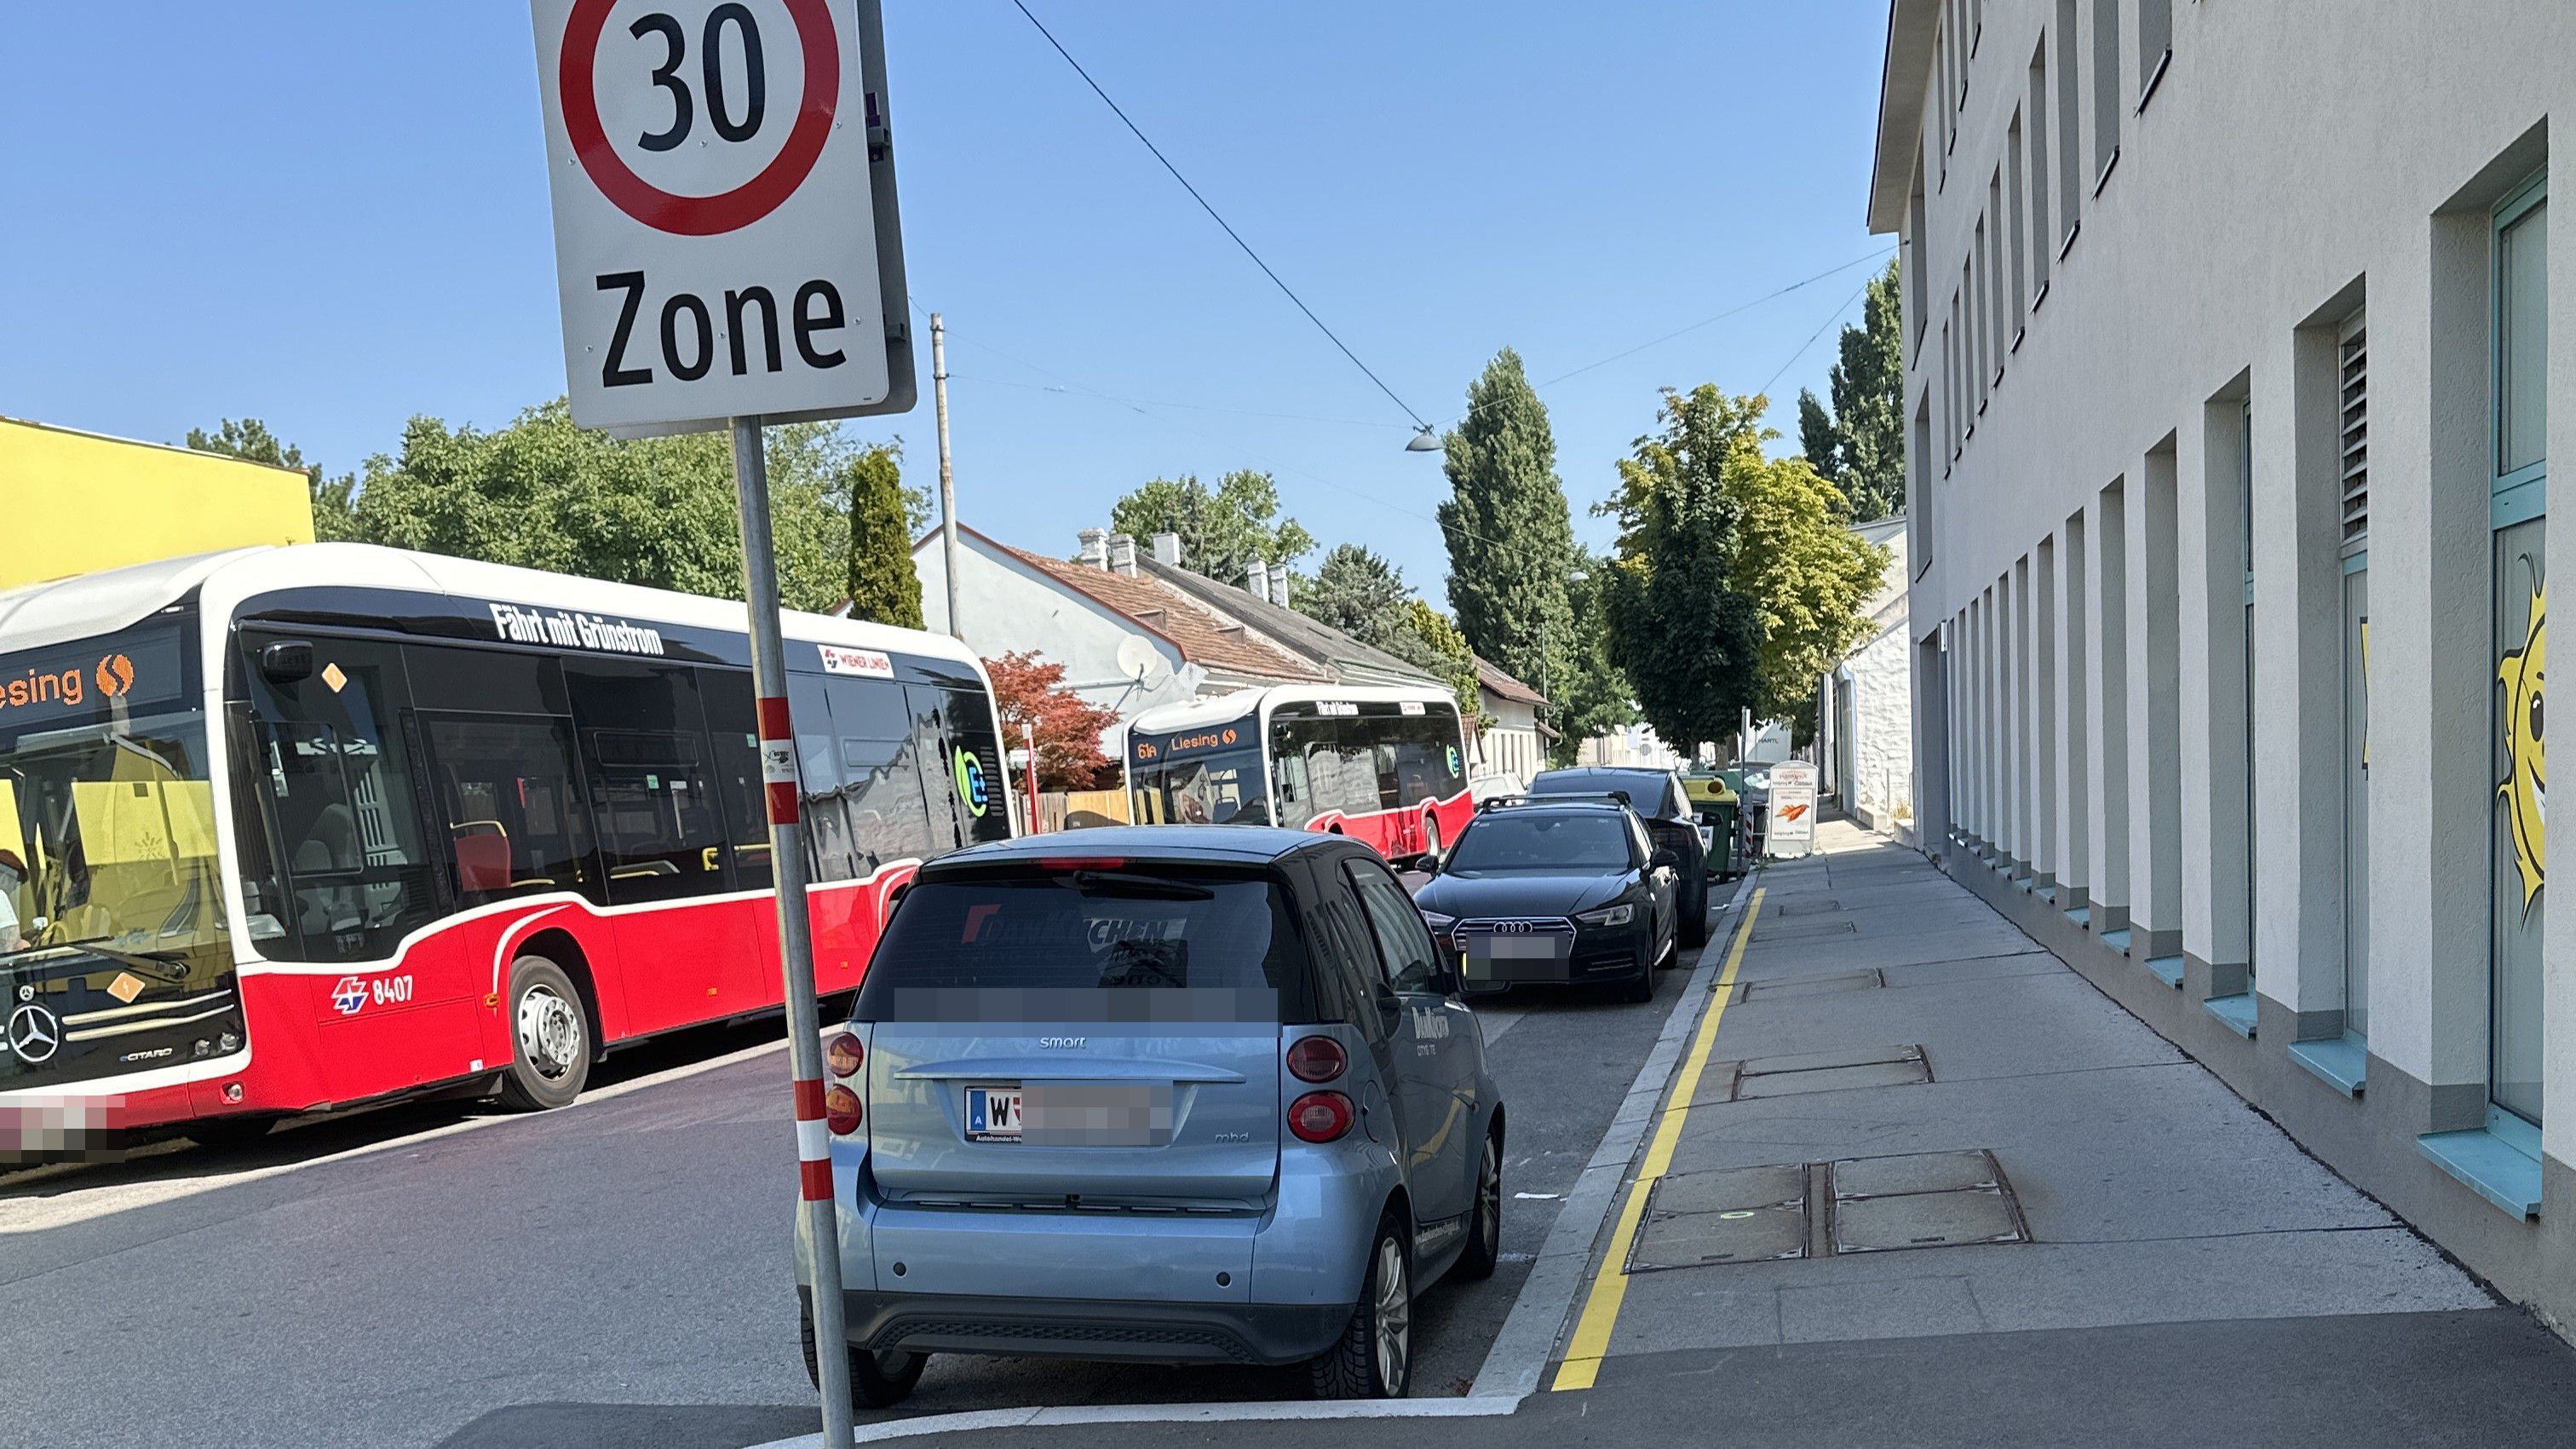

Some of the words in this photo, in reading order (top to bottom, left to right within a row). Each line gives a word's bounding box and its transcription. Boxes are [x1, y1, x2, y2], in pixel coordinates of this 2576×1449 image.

[629, 2, 766, 152] 30
[595, 270, 847, 388] Zone
[489, 603, 549, 643] Fährt
[545, 611, 581, 647] mit
[575, 612, 664, 655] Grünstrom
[839, 653, 867, 669] WIENER
[1171, 734, 1218, 750] Liesing
[371, 974, 413, 1005] 8407
[1039, 1037, 1086, 1049] smart
[974, 1115, 983, 1125] A
[990, 1096, 1009, 1127] W
[1215, 1131, 1250, 1143] mhd
